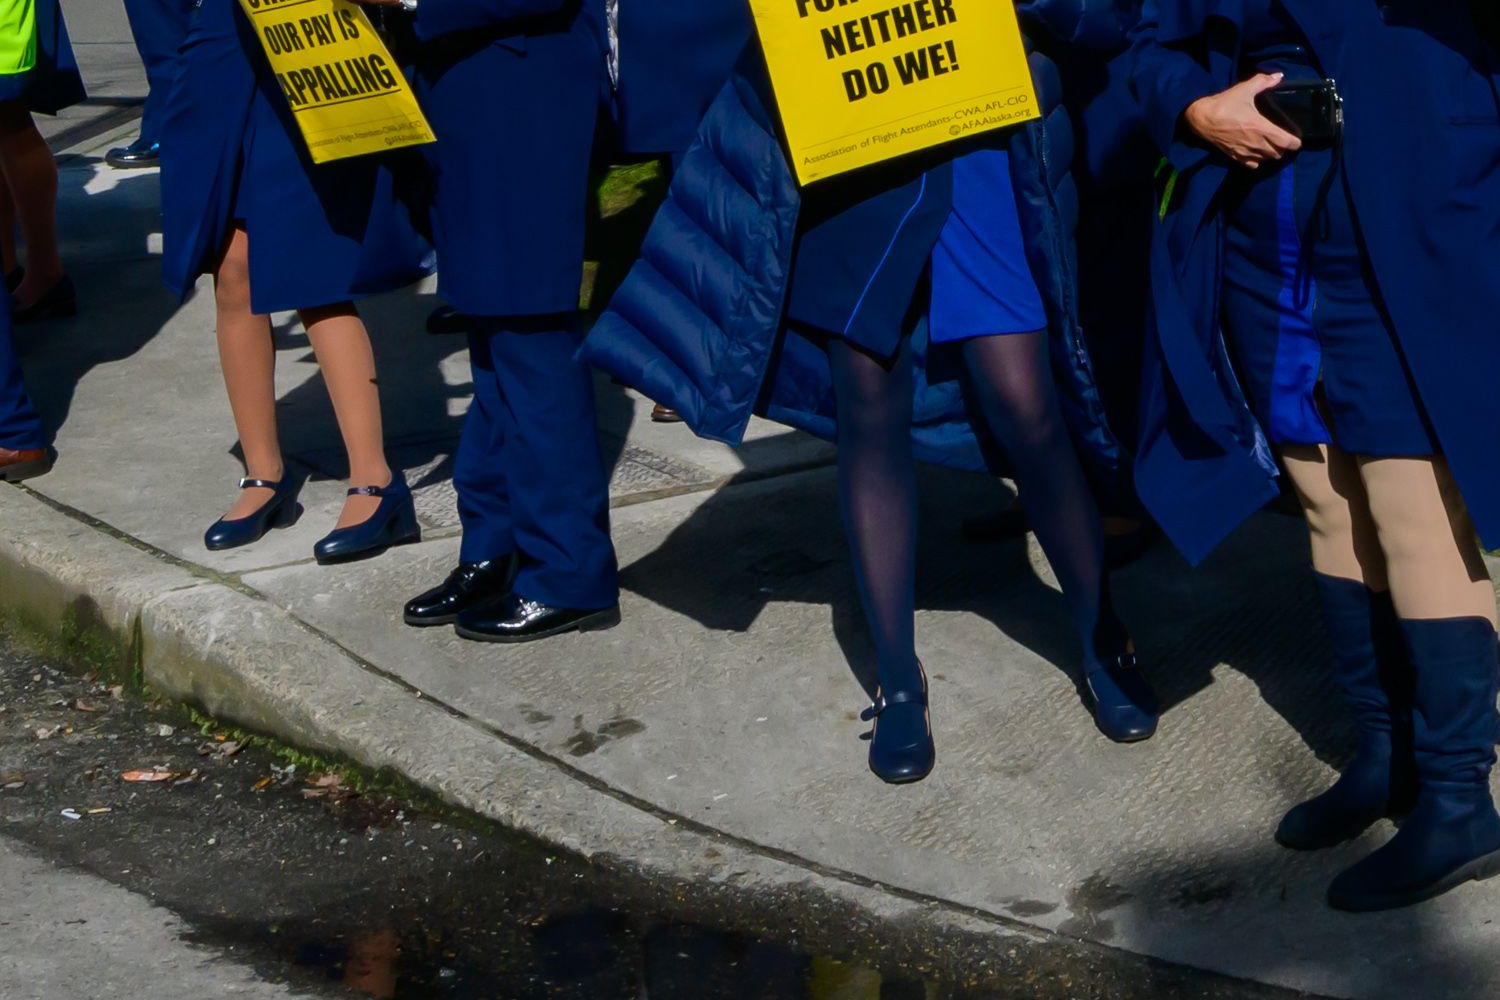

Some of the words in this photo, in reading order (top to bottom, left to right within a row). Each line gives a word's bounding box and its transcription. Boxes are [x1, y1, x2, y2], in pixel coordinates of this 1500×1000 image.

[264, 21, 305, 55] OUR
[299, 13, 337, 48] PAY
[334, 9, 360, 40] IS
[276, 54, 398, 107] APPALLING
[842, 61, 890, 103] DO
[893, 39, 960, 86] WE!
[803, 144, 858, 166] Association
[860, 137, 871, 149] of
[872, 130, 898, 144] Flight
[985, 94, 1028, 112] AFL-CIO
[961, 107, 1032, 132] AFAAlaska.org
